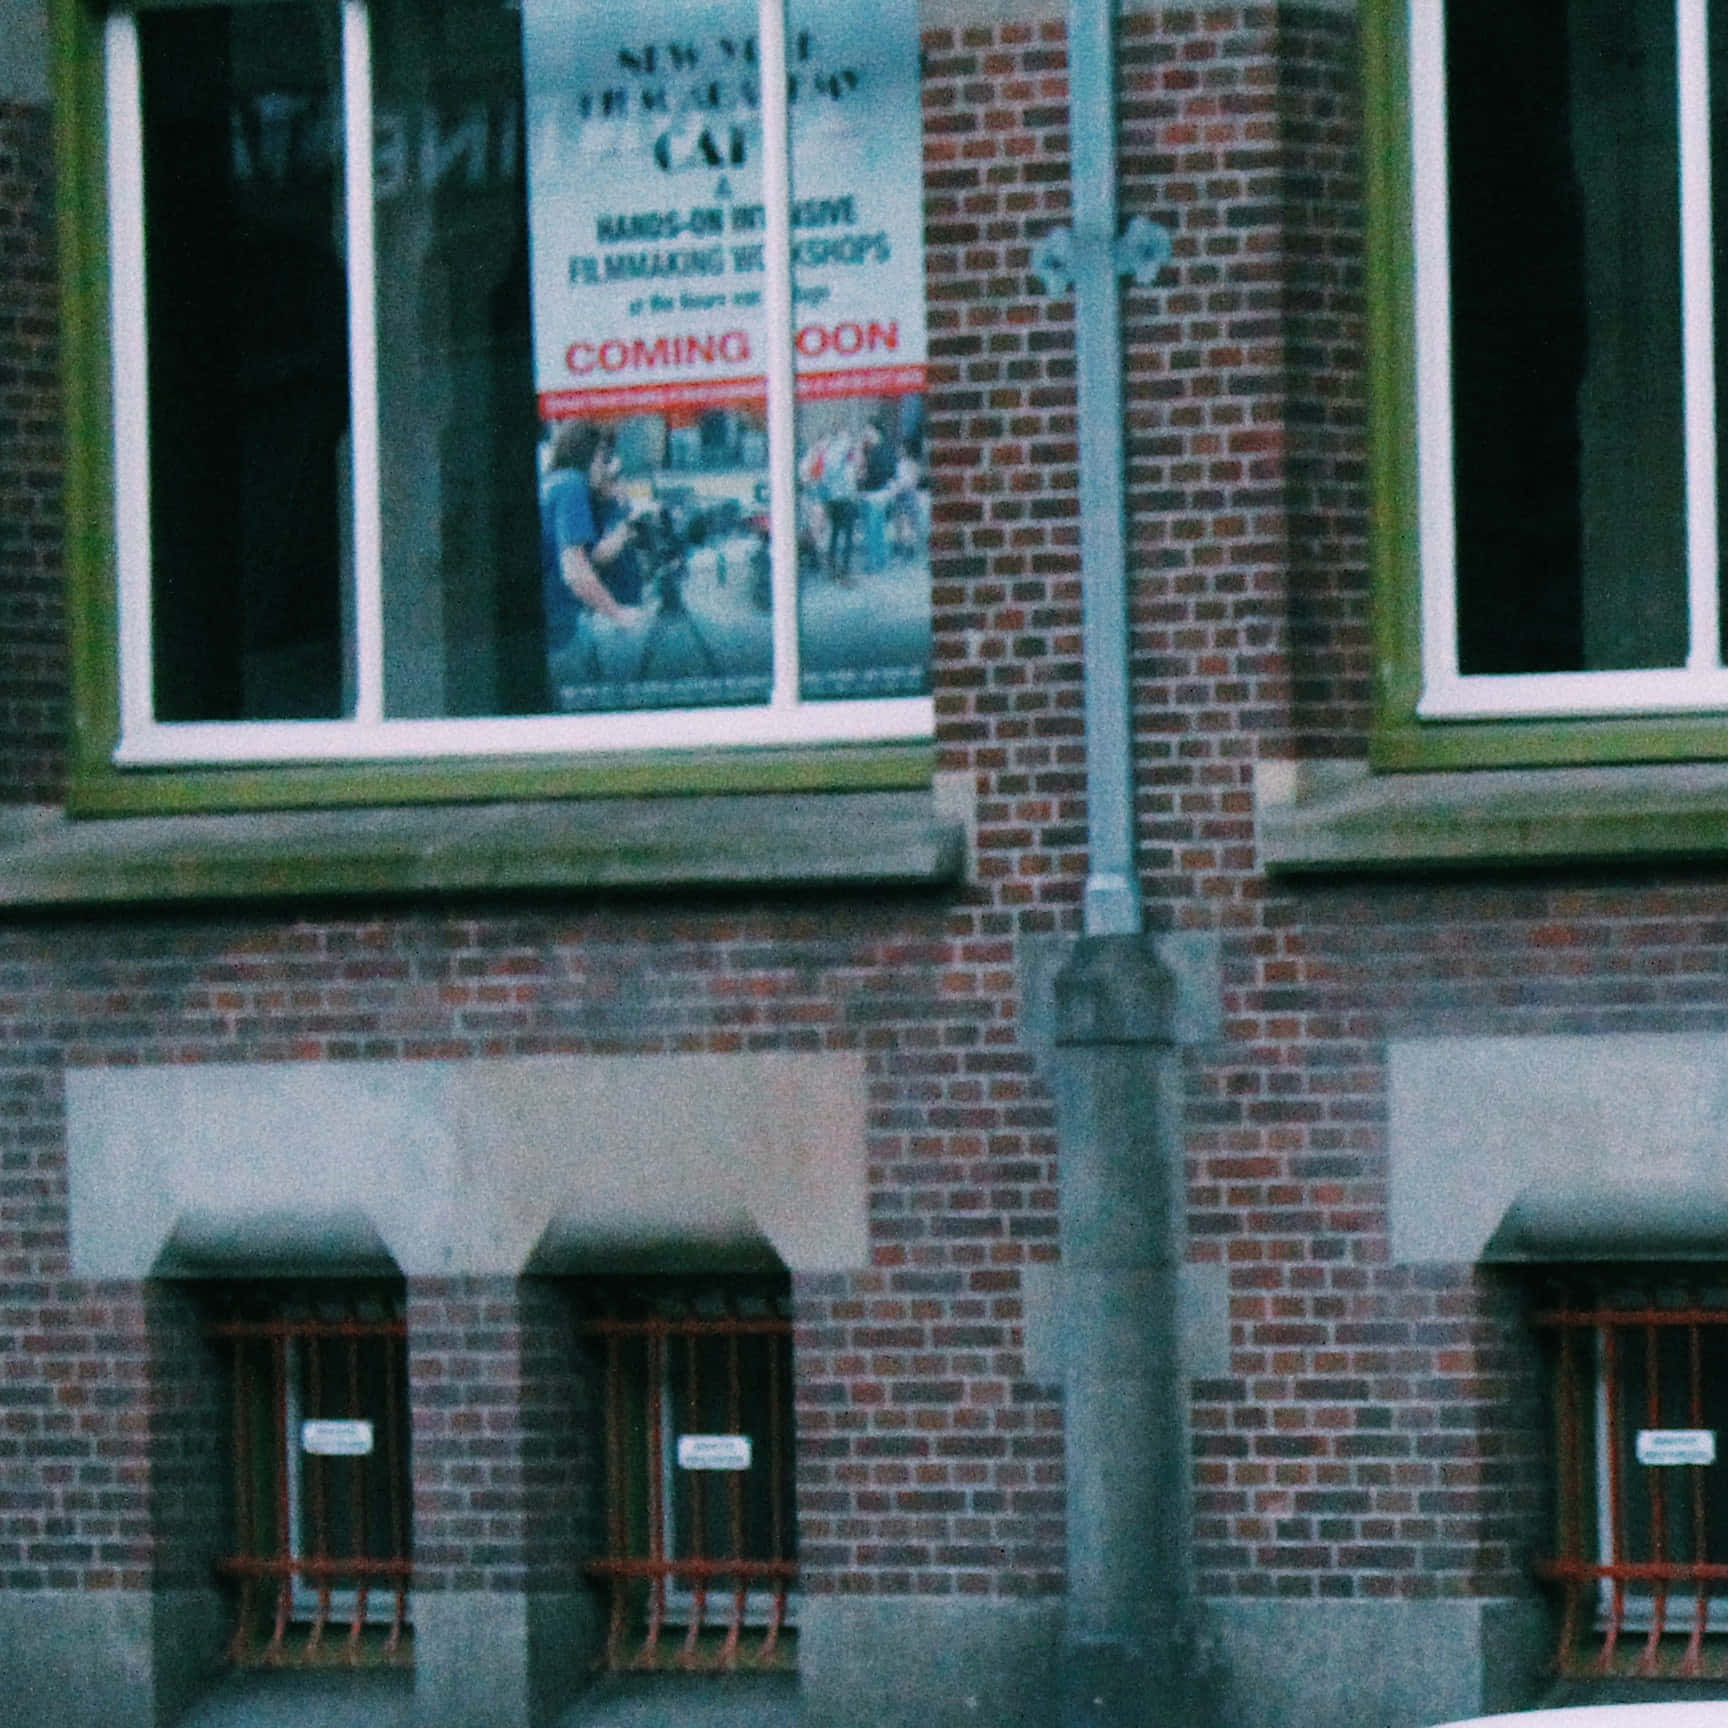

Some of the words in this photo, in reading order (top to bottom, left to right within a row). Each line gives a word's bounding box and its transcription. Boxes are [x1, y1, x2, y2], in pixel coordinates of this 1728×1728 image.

[568, 246, 725, 285] FILMMAKING
[566, 330, 750, 374] COMING
[795, 320, 899, 356] OON
